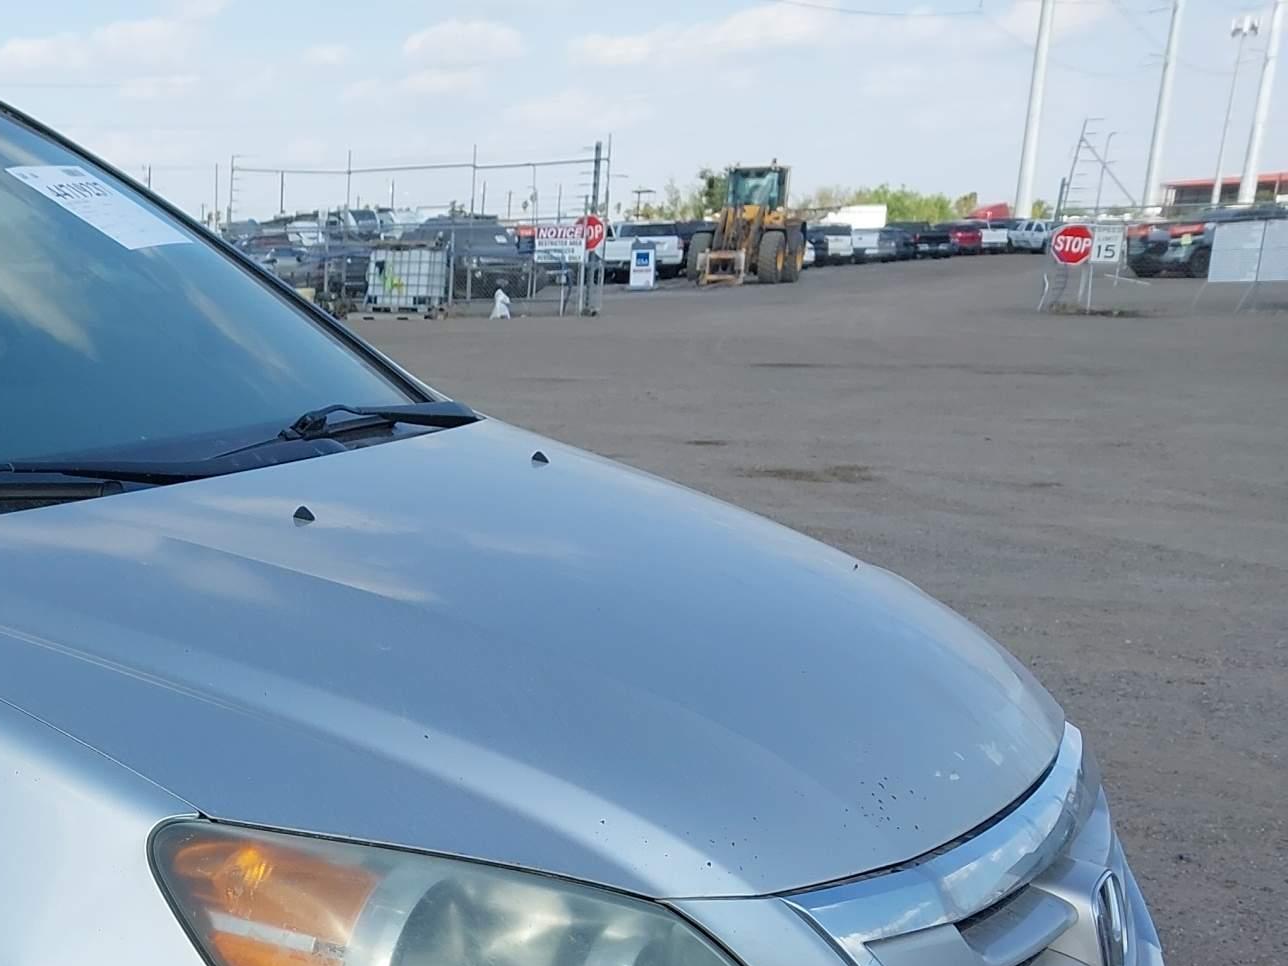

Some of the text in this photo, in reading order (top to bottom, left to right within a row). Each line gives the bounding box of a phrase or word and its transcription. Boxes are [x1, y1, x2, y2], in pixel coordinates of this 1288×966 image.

[539, 225, 584, 239] NOTICE
[1054, 235, 1092, 254] STOP
[1096, 244, 1116, 259] 15
